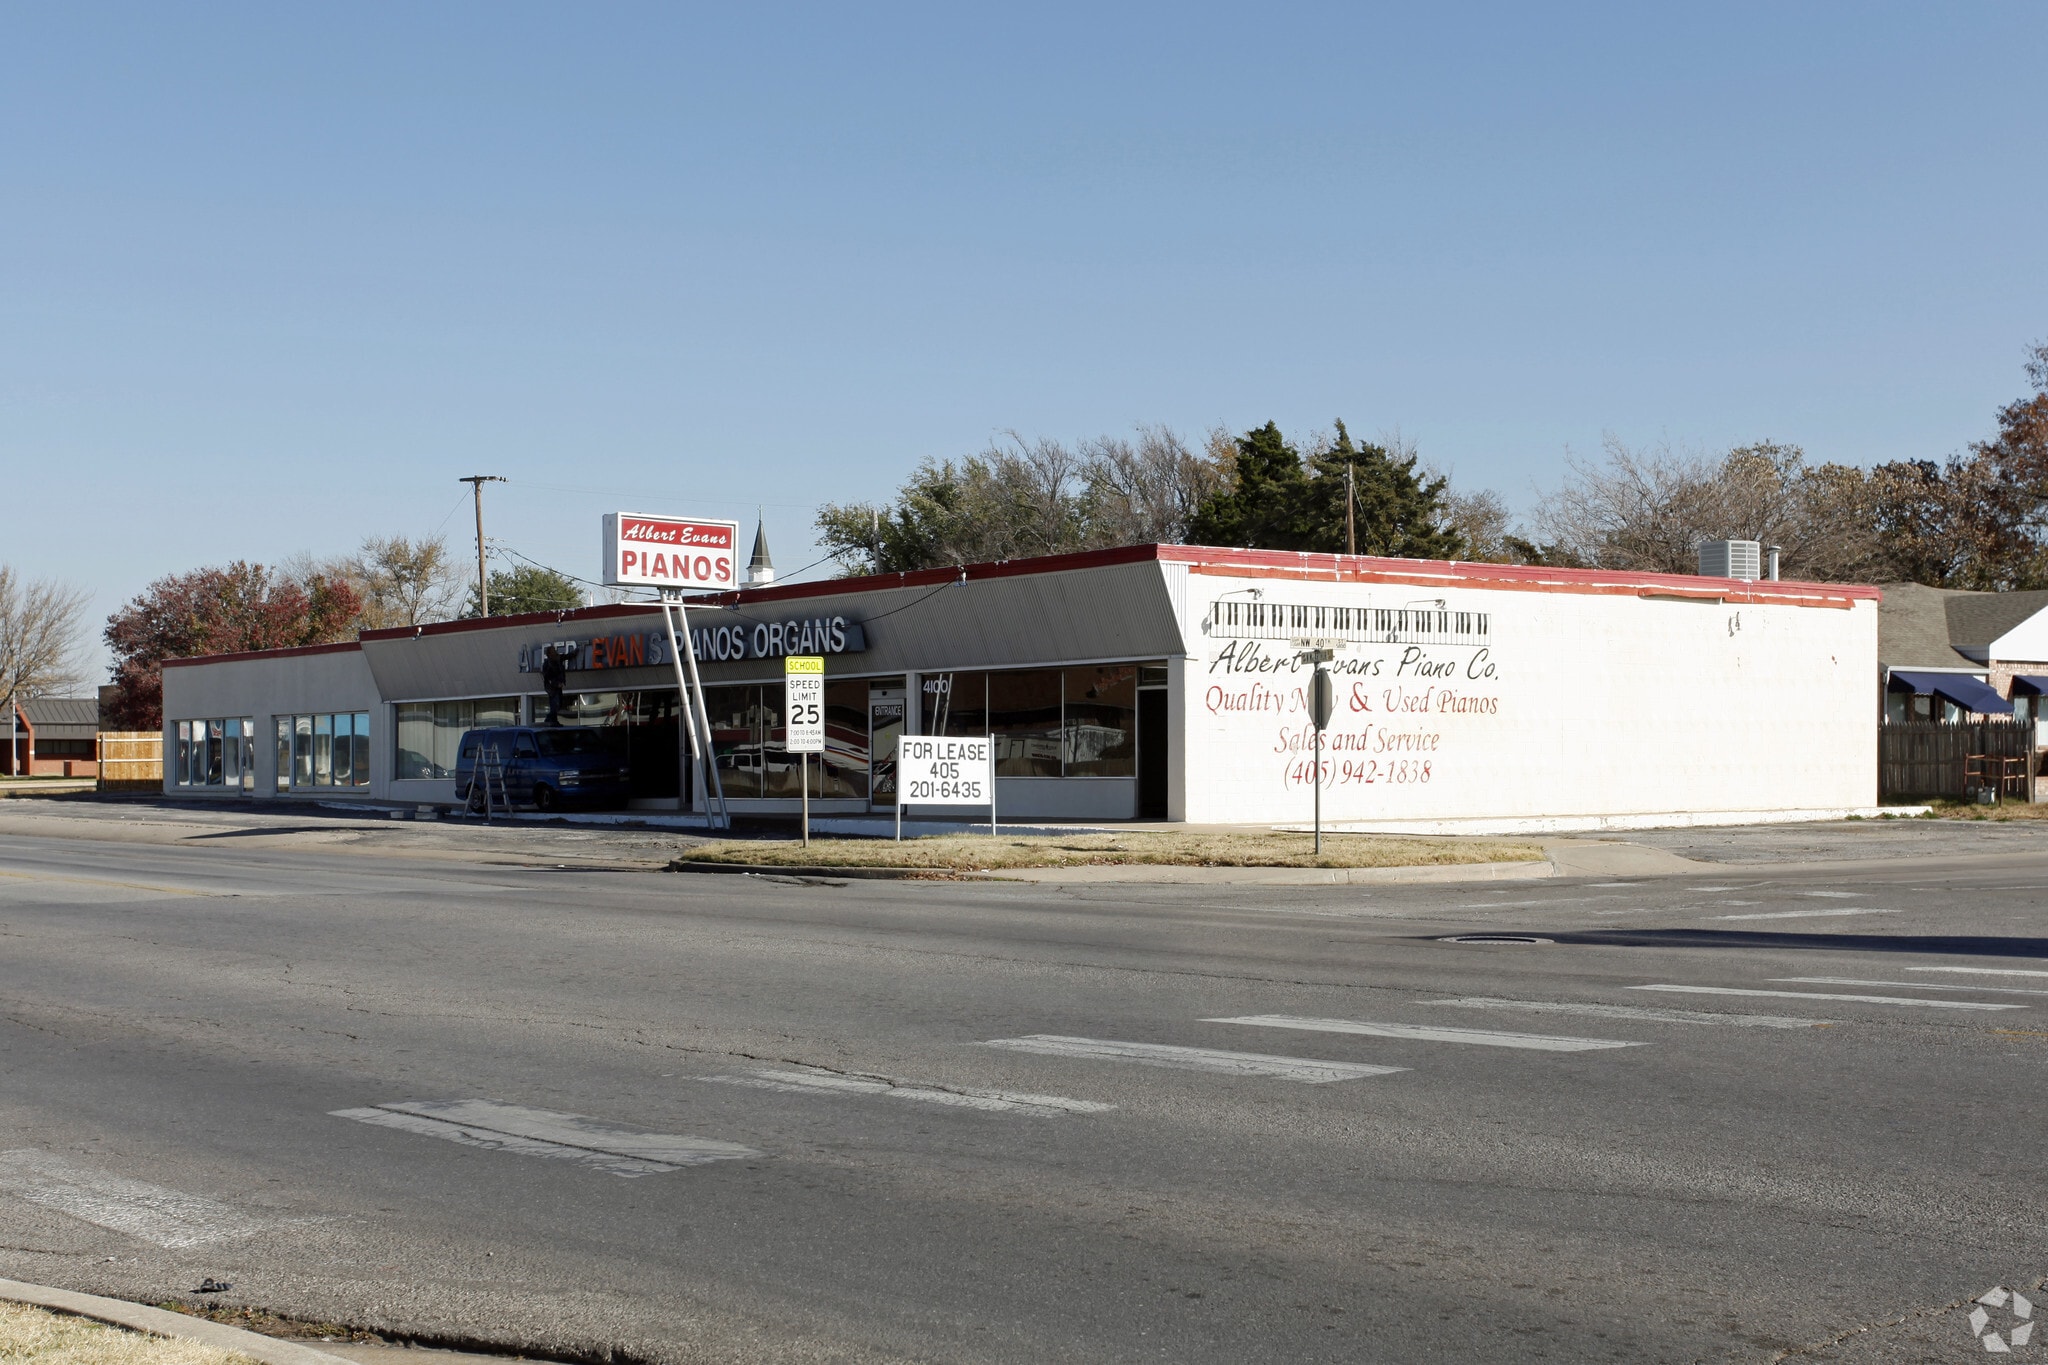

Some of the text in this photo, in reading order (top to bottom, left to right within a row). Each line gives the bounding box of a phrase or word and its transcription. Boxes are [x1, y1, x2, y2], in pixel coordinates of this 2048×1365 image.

[623, 524, 727, 545] Albert Evans
[622, 550, 731, 582] PIANOS
[674, 625, 744, 661] PANOS
[754, 616, 845, 657] ORGANS
[1301, 638, 1310, 647] NW
[789, 661, 821, 670] SCHOOL
[1209, 640, 1498, 680] Albert vans Piano Co.
[789, 680, 820, 689] SPEED
[923, 680, 949, 693] 4100
[792, 692, 817, 701] LIMIT
[1206, 682, 1284, 716] Quality
[1350, 681, 1373, 712] &
[1383, 685, 1434, 712] Used
[1436, 689, 1498, 714] Pianos
[791, 704, 820, 725] 25
[875, 706, 902, 716] ENTRANCE
[1274, 723, 1440, 753] Sales and Service
[903, 742, 986, 761] FOR LEASE
[930, 762, 959, 779] 405
[1284, 756, 1432, 791] (405) 942-1838
[910, 781, 981, 798] 201-6435
